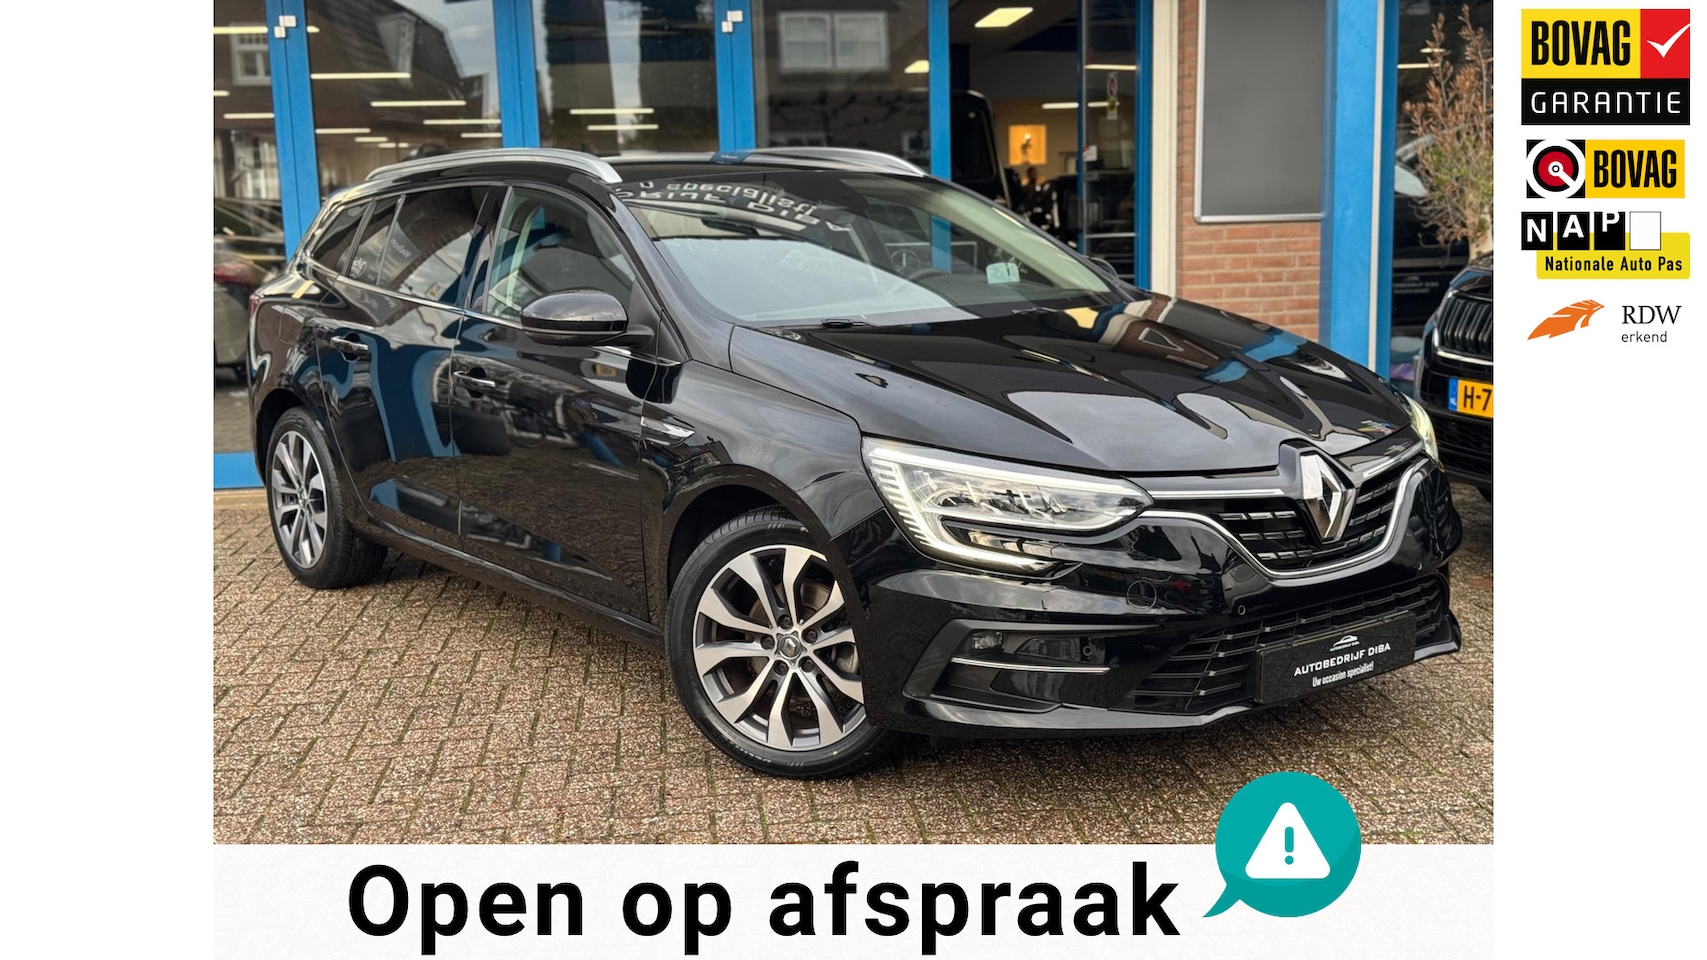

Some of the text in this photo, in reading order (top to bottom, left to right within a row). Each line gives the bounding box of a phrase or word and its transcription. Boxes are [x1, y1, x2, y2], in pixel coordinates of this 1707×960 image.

[1293, 649, 1366, 677] AUTOBEDRIJF
[1367, 642, 1392, 657] DIBA
[1312, 676, 1322, 688] Uw
[1322, 670, 1347, 685] occasion
